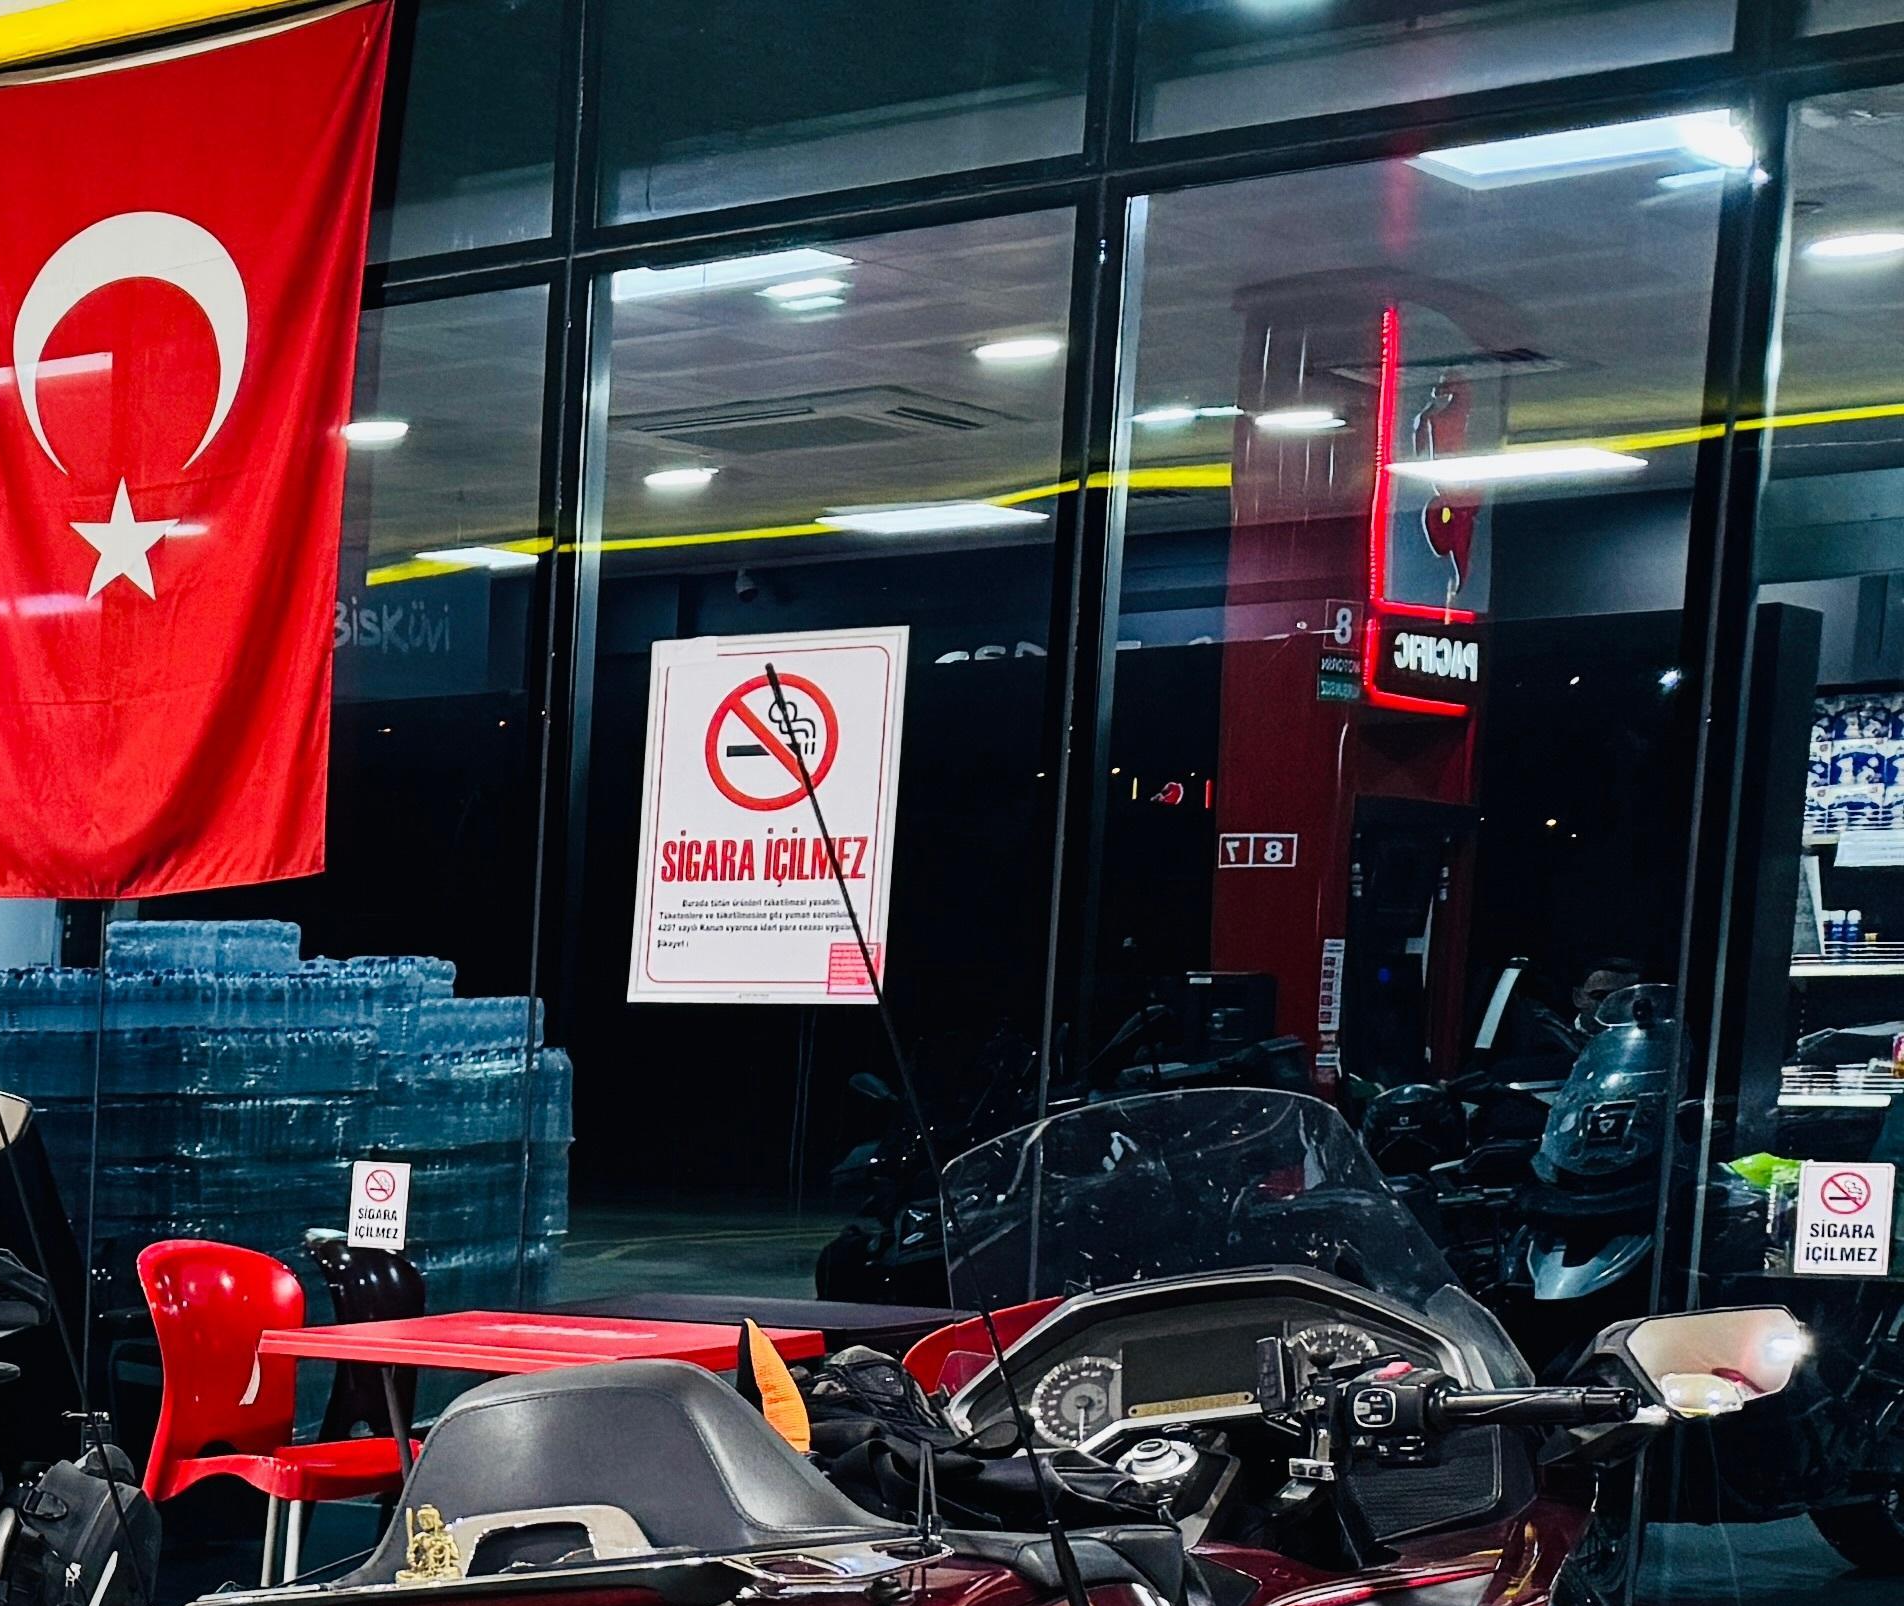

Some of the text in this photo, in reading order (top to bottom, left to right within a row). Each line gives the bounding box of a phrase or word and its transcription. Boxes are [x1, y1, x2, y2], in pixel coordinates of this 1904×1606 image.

[661, 827, 869, 887] SİGARA İÇİLMEZ
[357, 1205, 397, 1221] SİGARA
[354, 1223, 400, 1239] İÇİLMEZ
[1810, 1219, 1875, 1238] SİGARA
[1805, 1242, 1878, 1264] İÇİLMEZ
